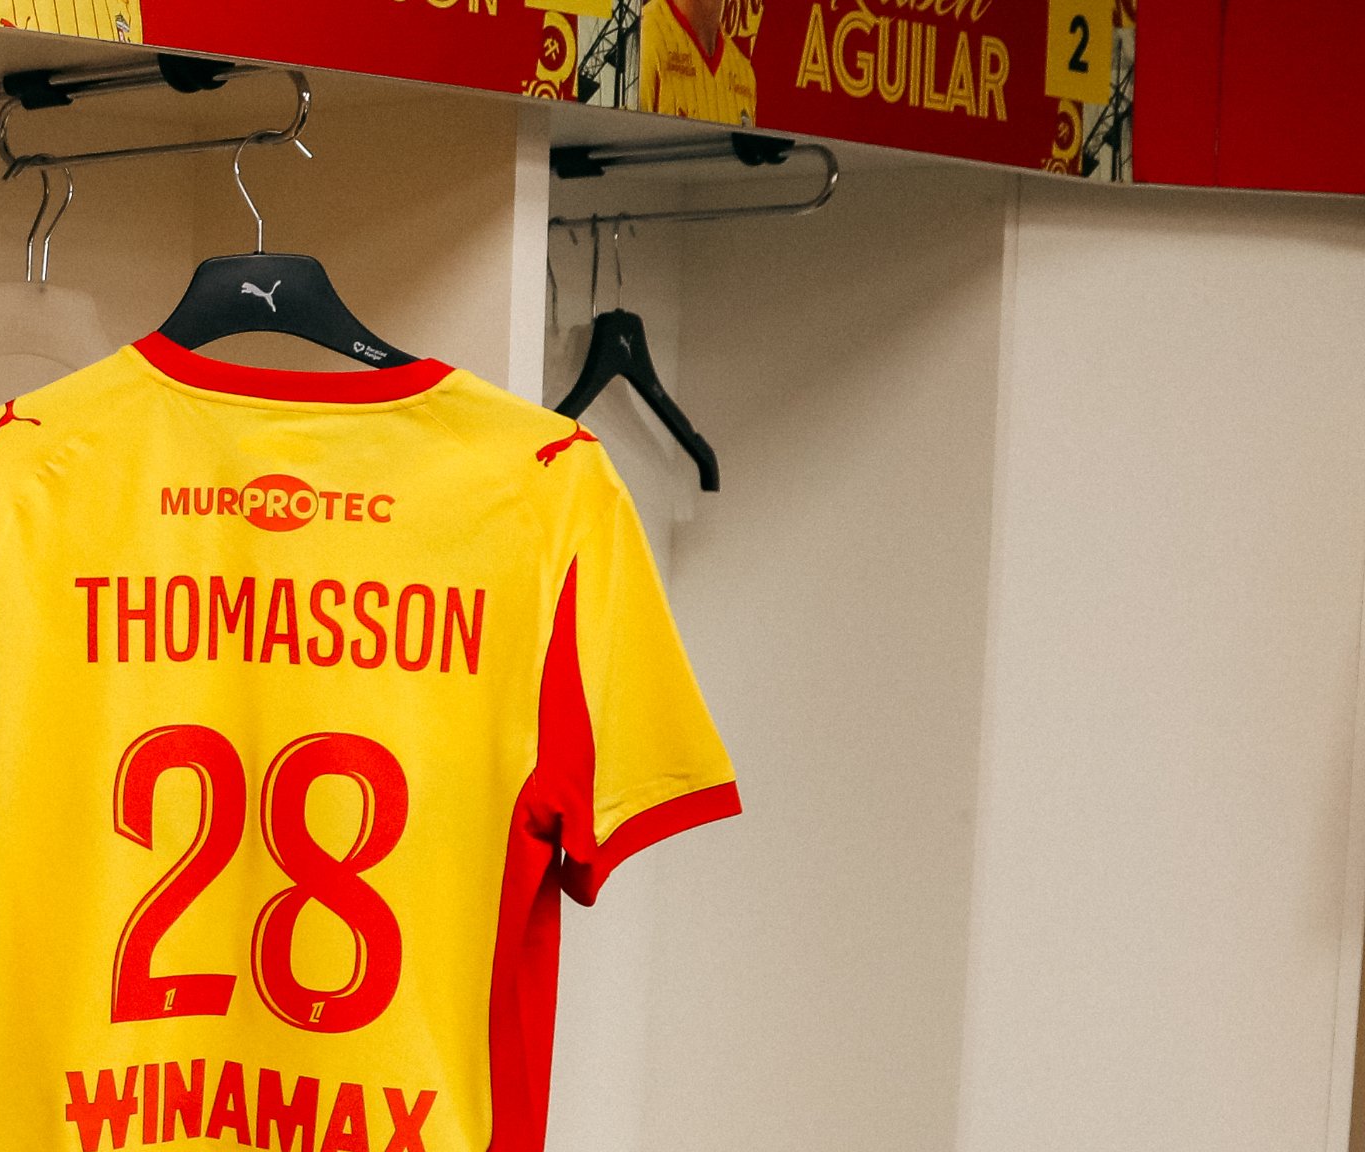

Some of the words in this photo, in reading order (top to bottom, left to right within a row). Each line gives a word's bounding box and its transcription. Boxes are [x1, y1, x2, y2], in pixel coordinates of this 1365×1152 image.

[796, 3, 1010, 122] AGUILAR
[1068, 14, 1090, 74] 2
[161, 486, 395, 524] MURPROTEC
[75, 574, 485, 675] THOMASSON
[110, 724, 409, 1034] 28
